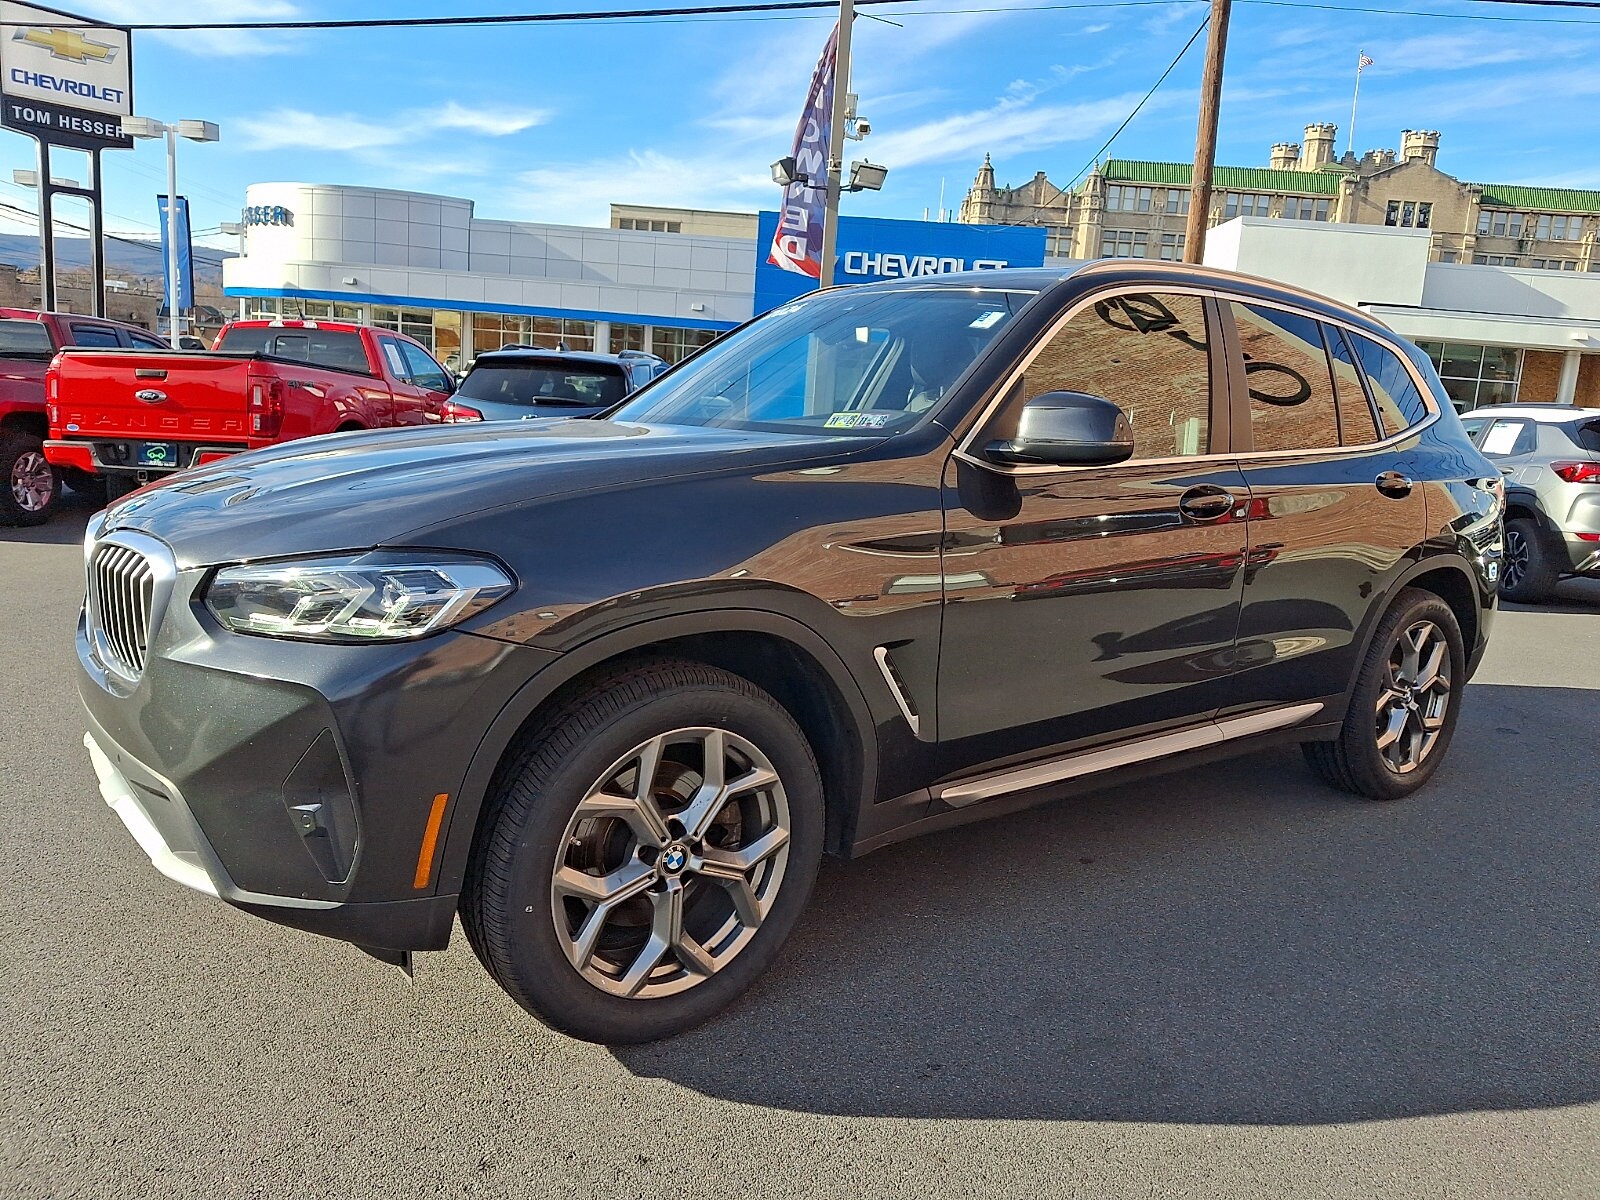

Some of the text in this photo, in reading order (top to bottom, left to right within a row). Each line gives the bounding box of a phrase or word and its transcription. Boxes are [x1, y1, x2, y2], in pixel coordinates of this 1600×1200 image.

[11, 68, 124, 104] CHEVROLET
[11, 105, 125, 139] TOM HESSER
[68, 413, 243, 431] RANGER
[662, 846, 686, 862] BMW
